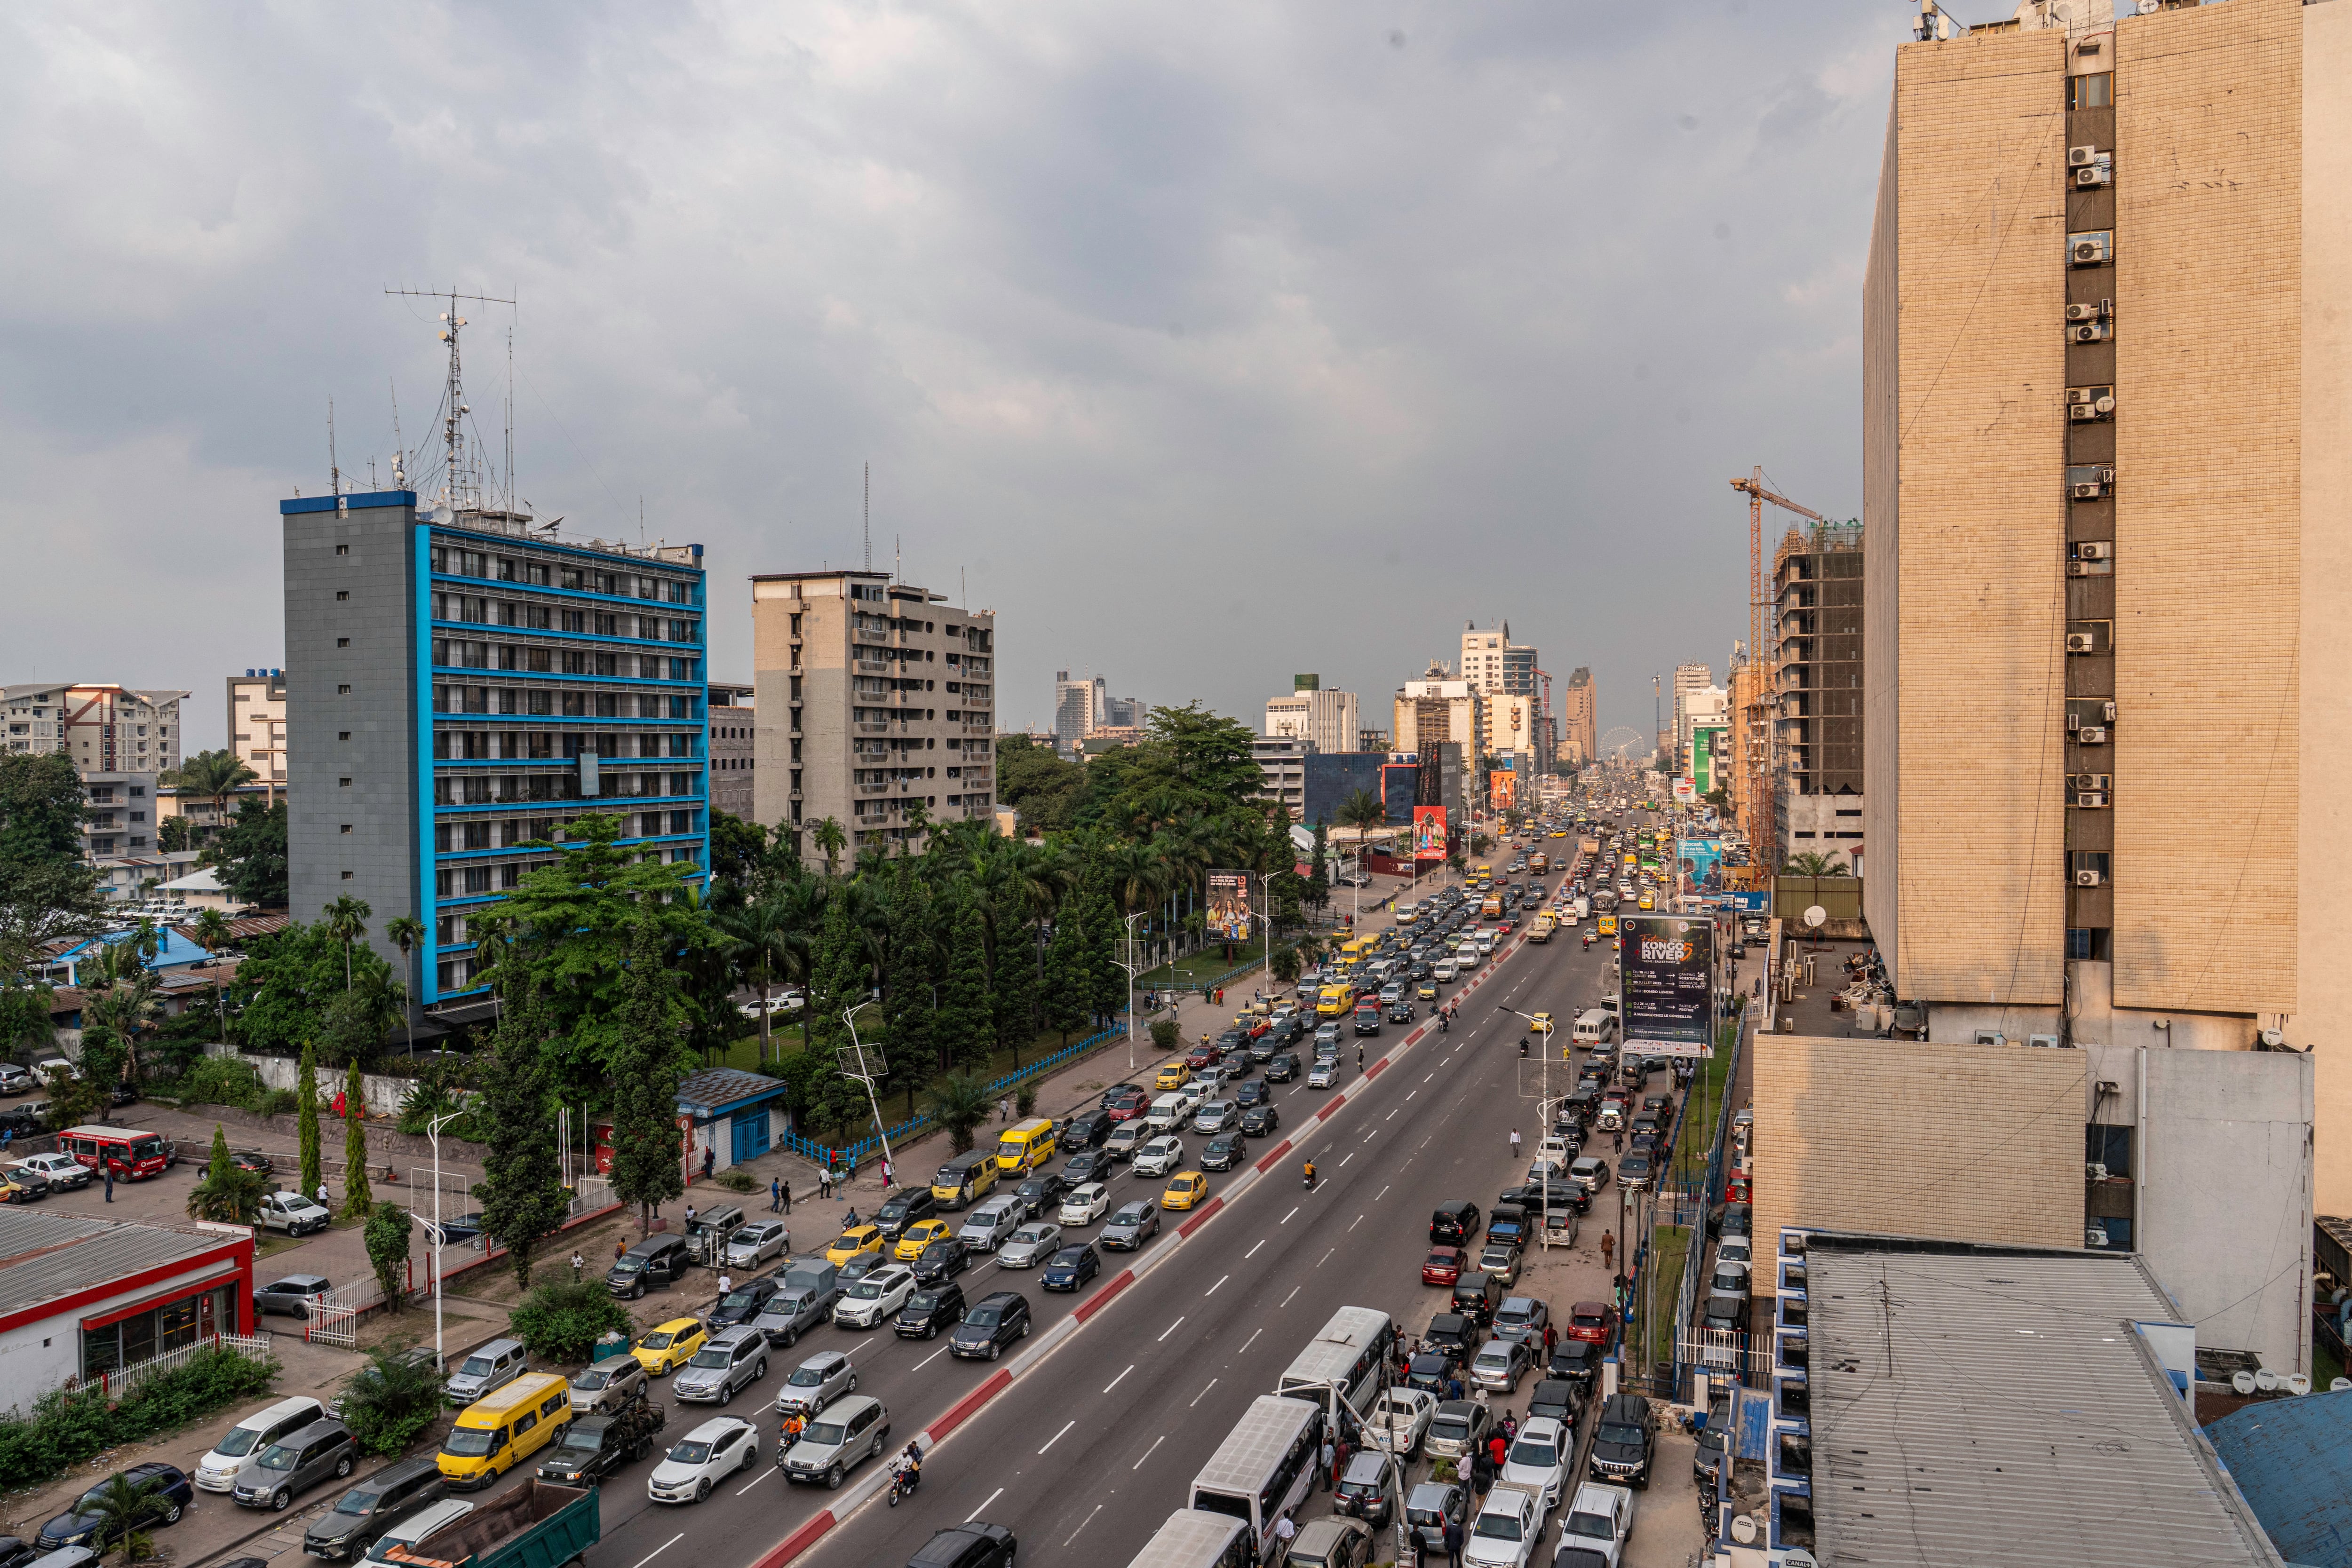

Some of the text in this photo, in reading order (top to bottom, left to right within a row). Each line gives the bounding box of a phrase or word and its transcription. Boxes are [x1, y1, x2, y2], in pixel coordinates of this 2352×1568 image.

[1642, 942, 1693, 961] KONGO 5
[1642, 950, 1685, 960] RIVER
